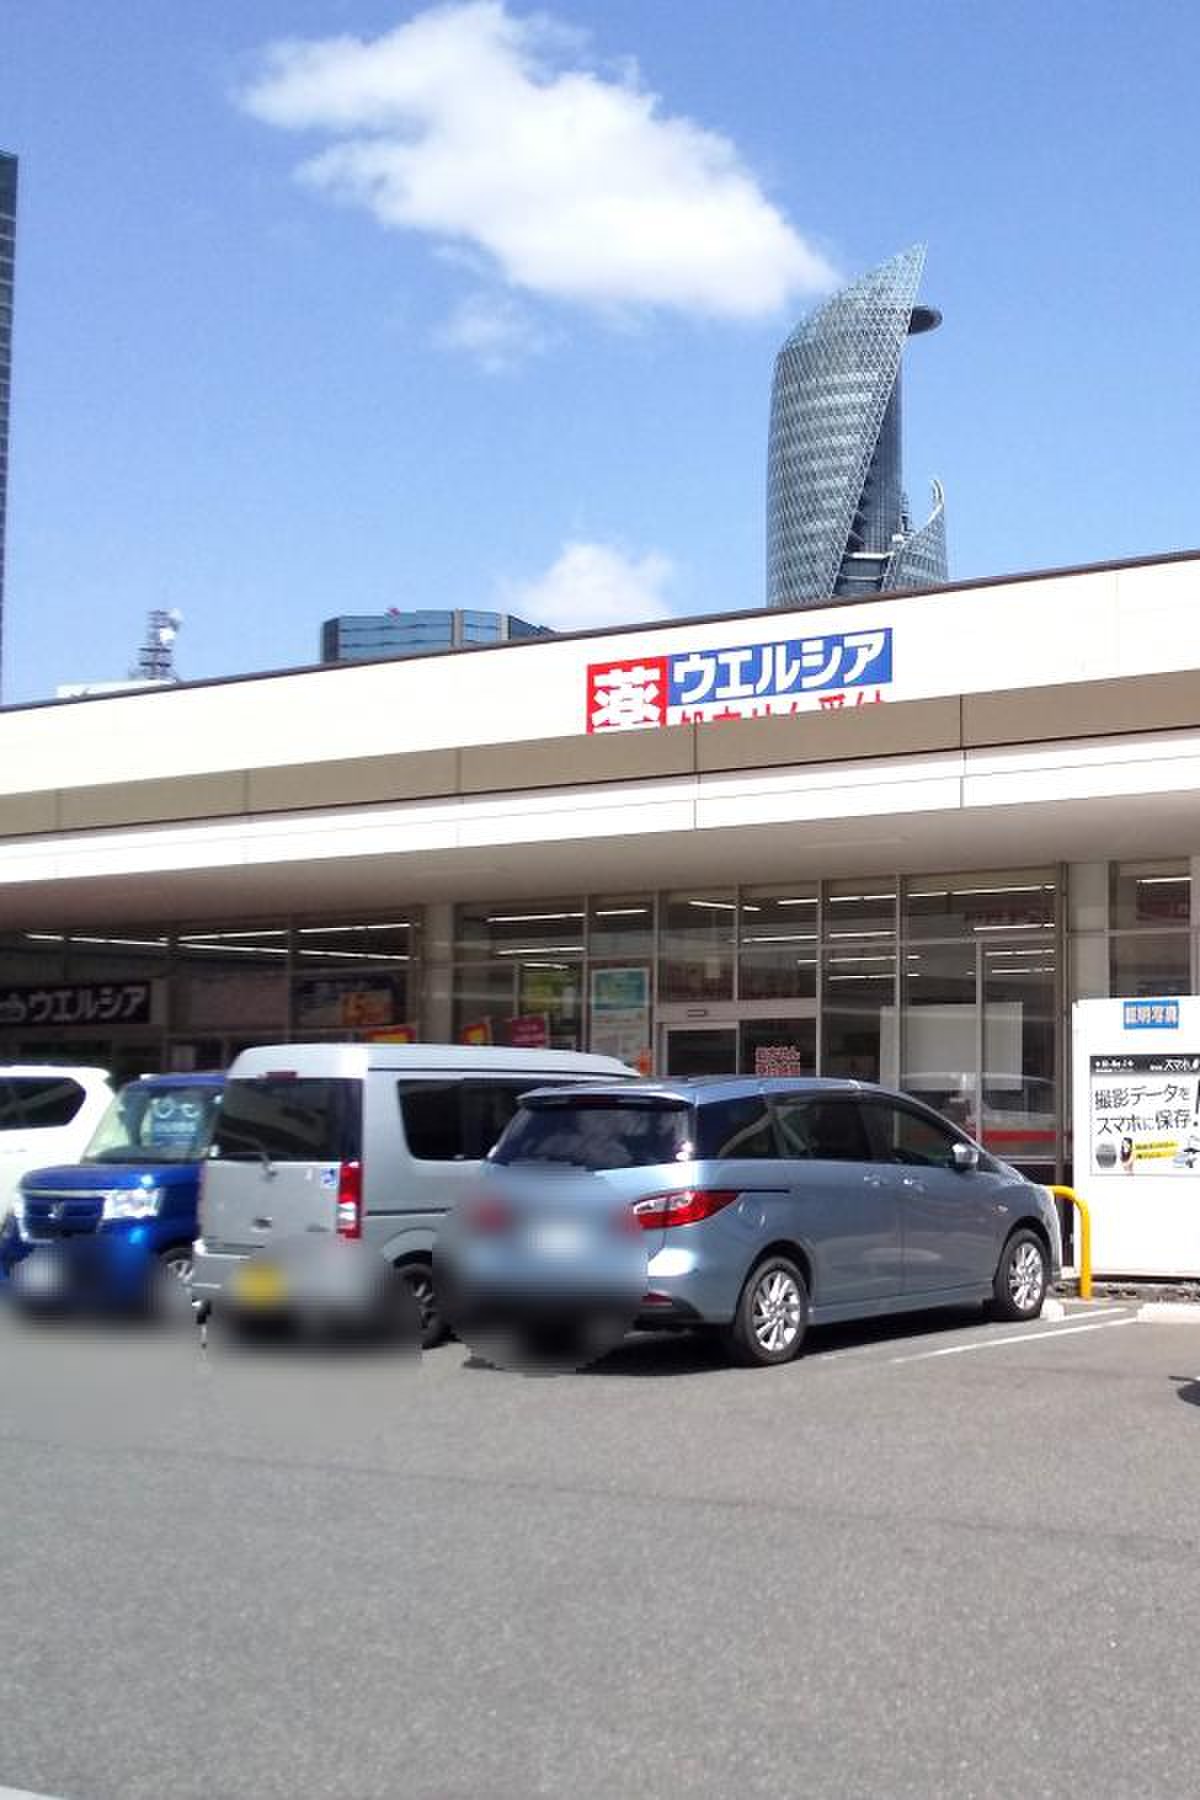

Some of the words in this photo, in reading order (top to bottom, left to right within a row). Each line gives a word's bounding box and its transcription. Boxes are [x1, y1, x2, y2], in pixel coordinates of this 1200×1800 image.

[592, 665, 662, 732] 薬
[672, 631, 886, 704] ウエルシア
[29, 986, 145, 1022] ウエルシア
